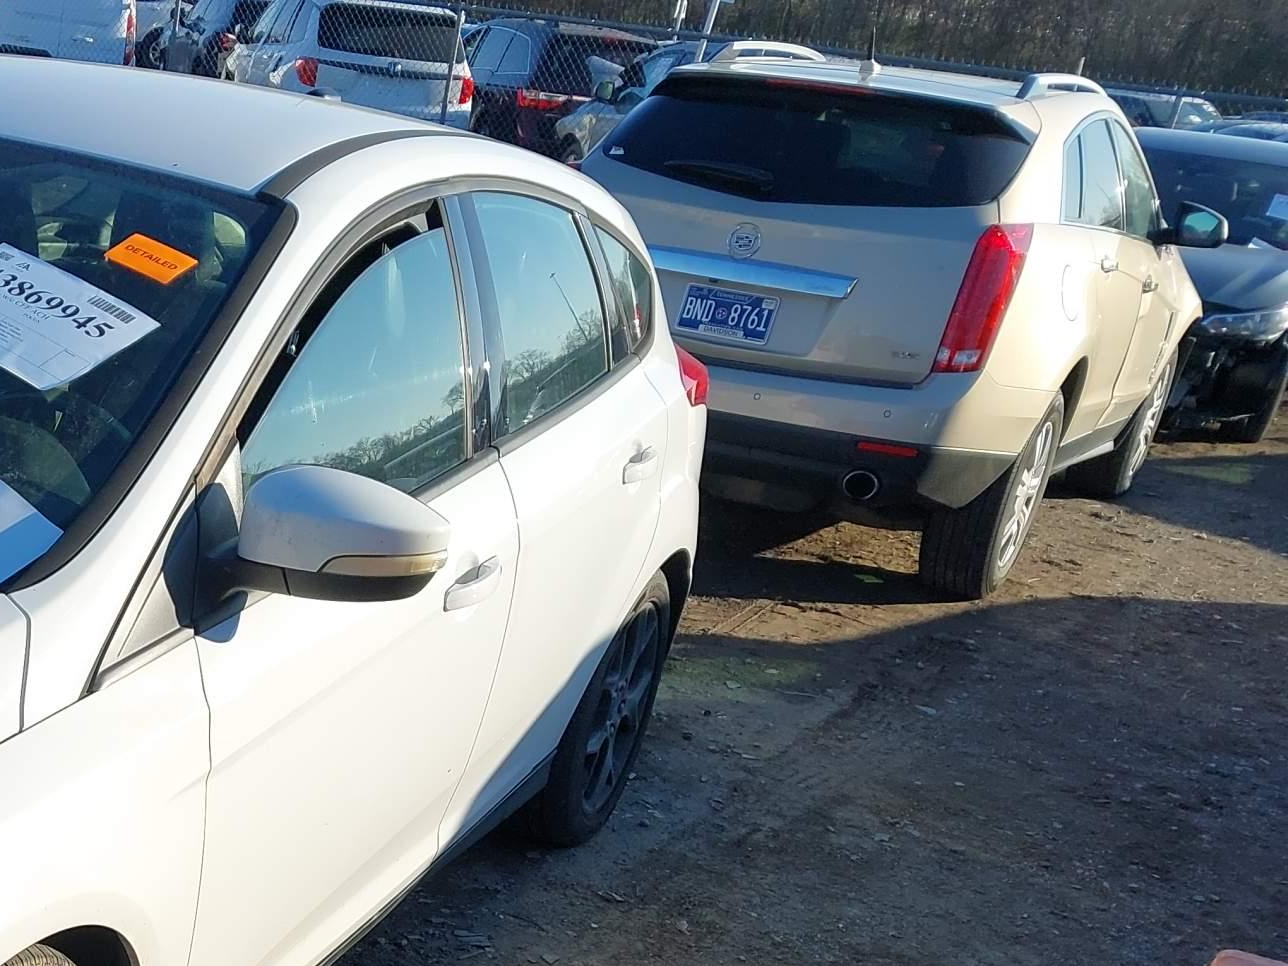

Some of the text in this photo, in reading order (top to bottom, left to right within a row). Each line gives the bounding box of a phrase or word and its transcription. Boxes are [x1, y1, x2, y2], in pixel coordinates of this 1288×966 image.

[125, 244, 179, 270] DETAILED
[682, 296, 769, 331] BND 8761
